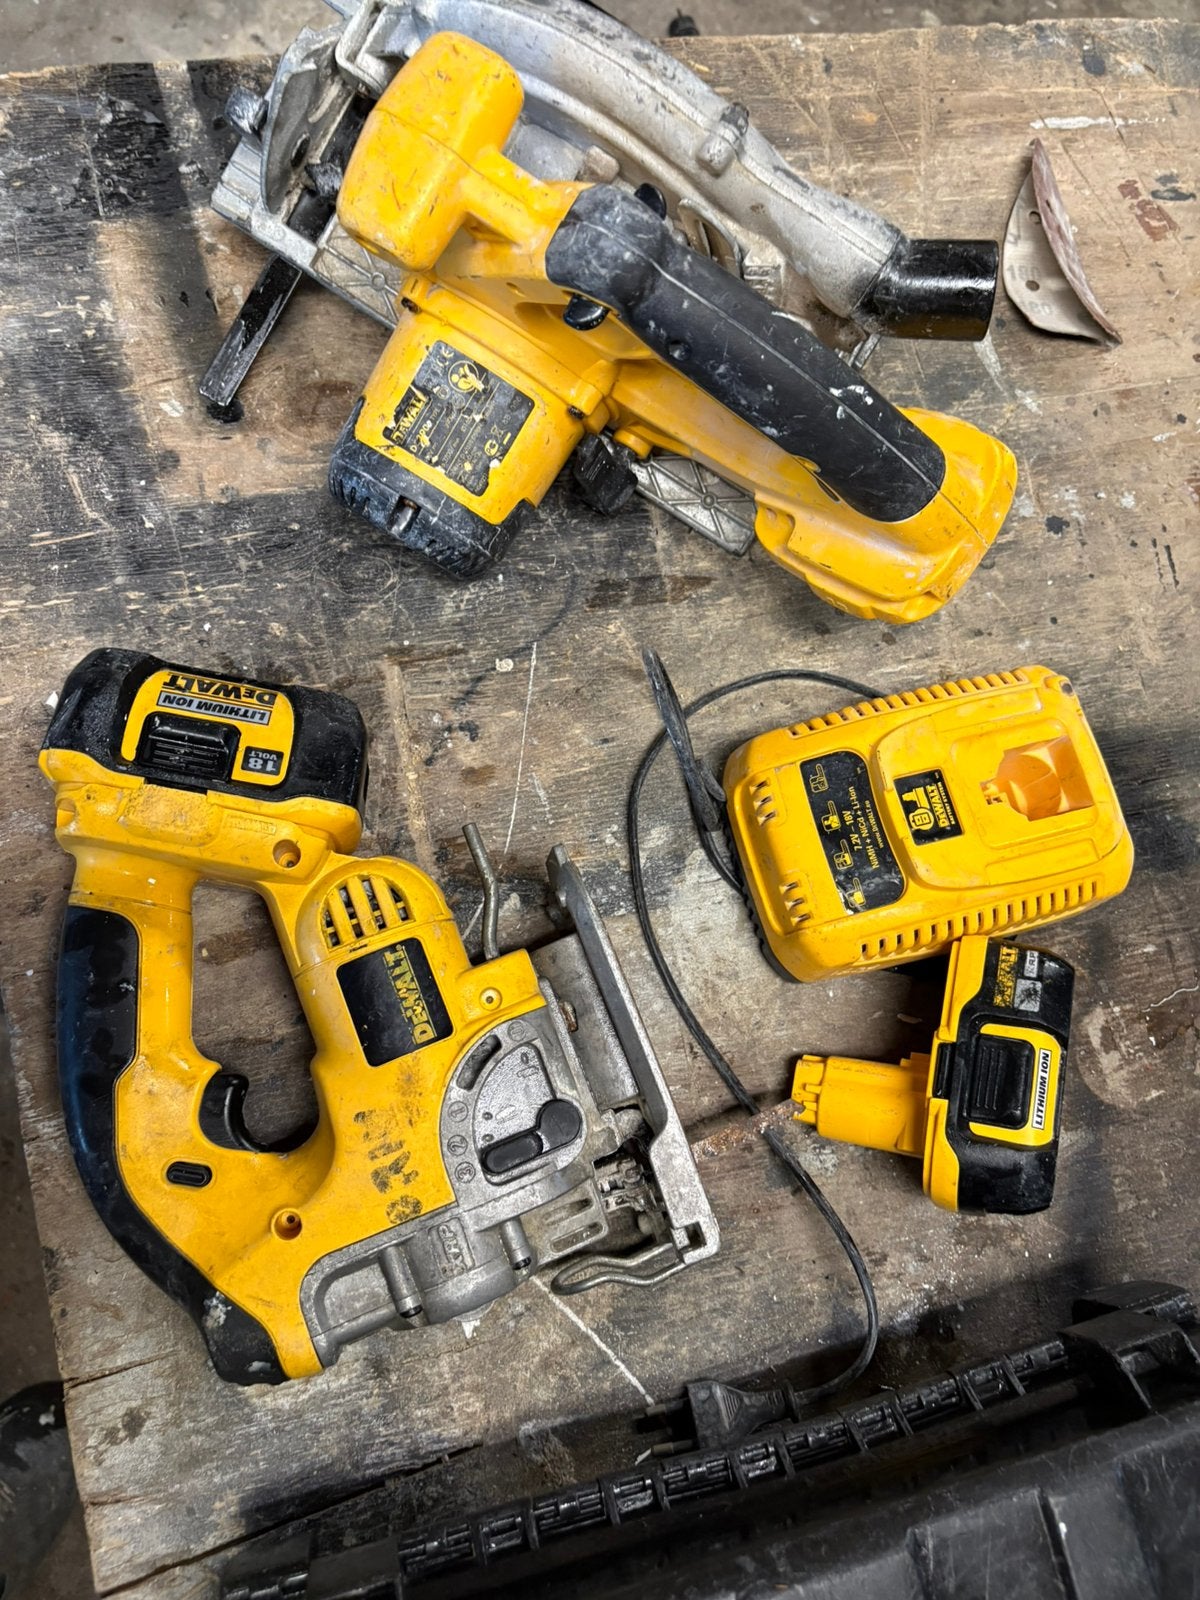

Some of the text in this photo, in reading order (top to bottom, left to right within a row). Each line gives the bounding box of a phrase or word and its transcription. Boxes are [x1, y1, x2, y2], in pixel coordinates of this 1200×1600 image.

[390, 391, 428, 444] DEWAL
[163, 673, 277, 705] DEWALT
[162, 694, 267, 721] LITHIUM ION
[247, 757, 276, 771] 18
[248, 749, 277, 760] VOLT
[848, 787, 860, 809] Li-Ion
[926, 785, 949, 828] DEWALT
[938, 782, 955, 825] BATTERY SYSTEM
[842, 811, 854, 825] 18V
[857, 817, 869, 837] NiCd
[850, 834, 862, 851] 7.2V
[866, 845, 879, 869] NiMH
[382, 949, 435, 1044] DEWALT
[1035, 1053, 1050, 1126] LITHIUM ION
